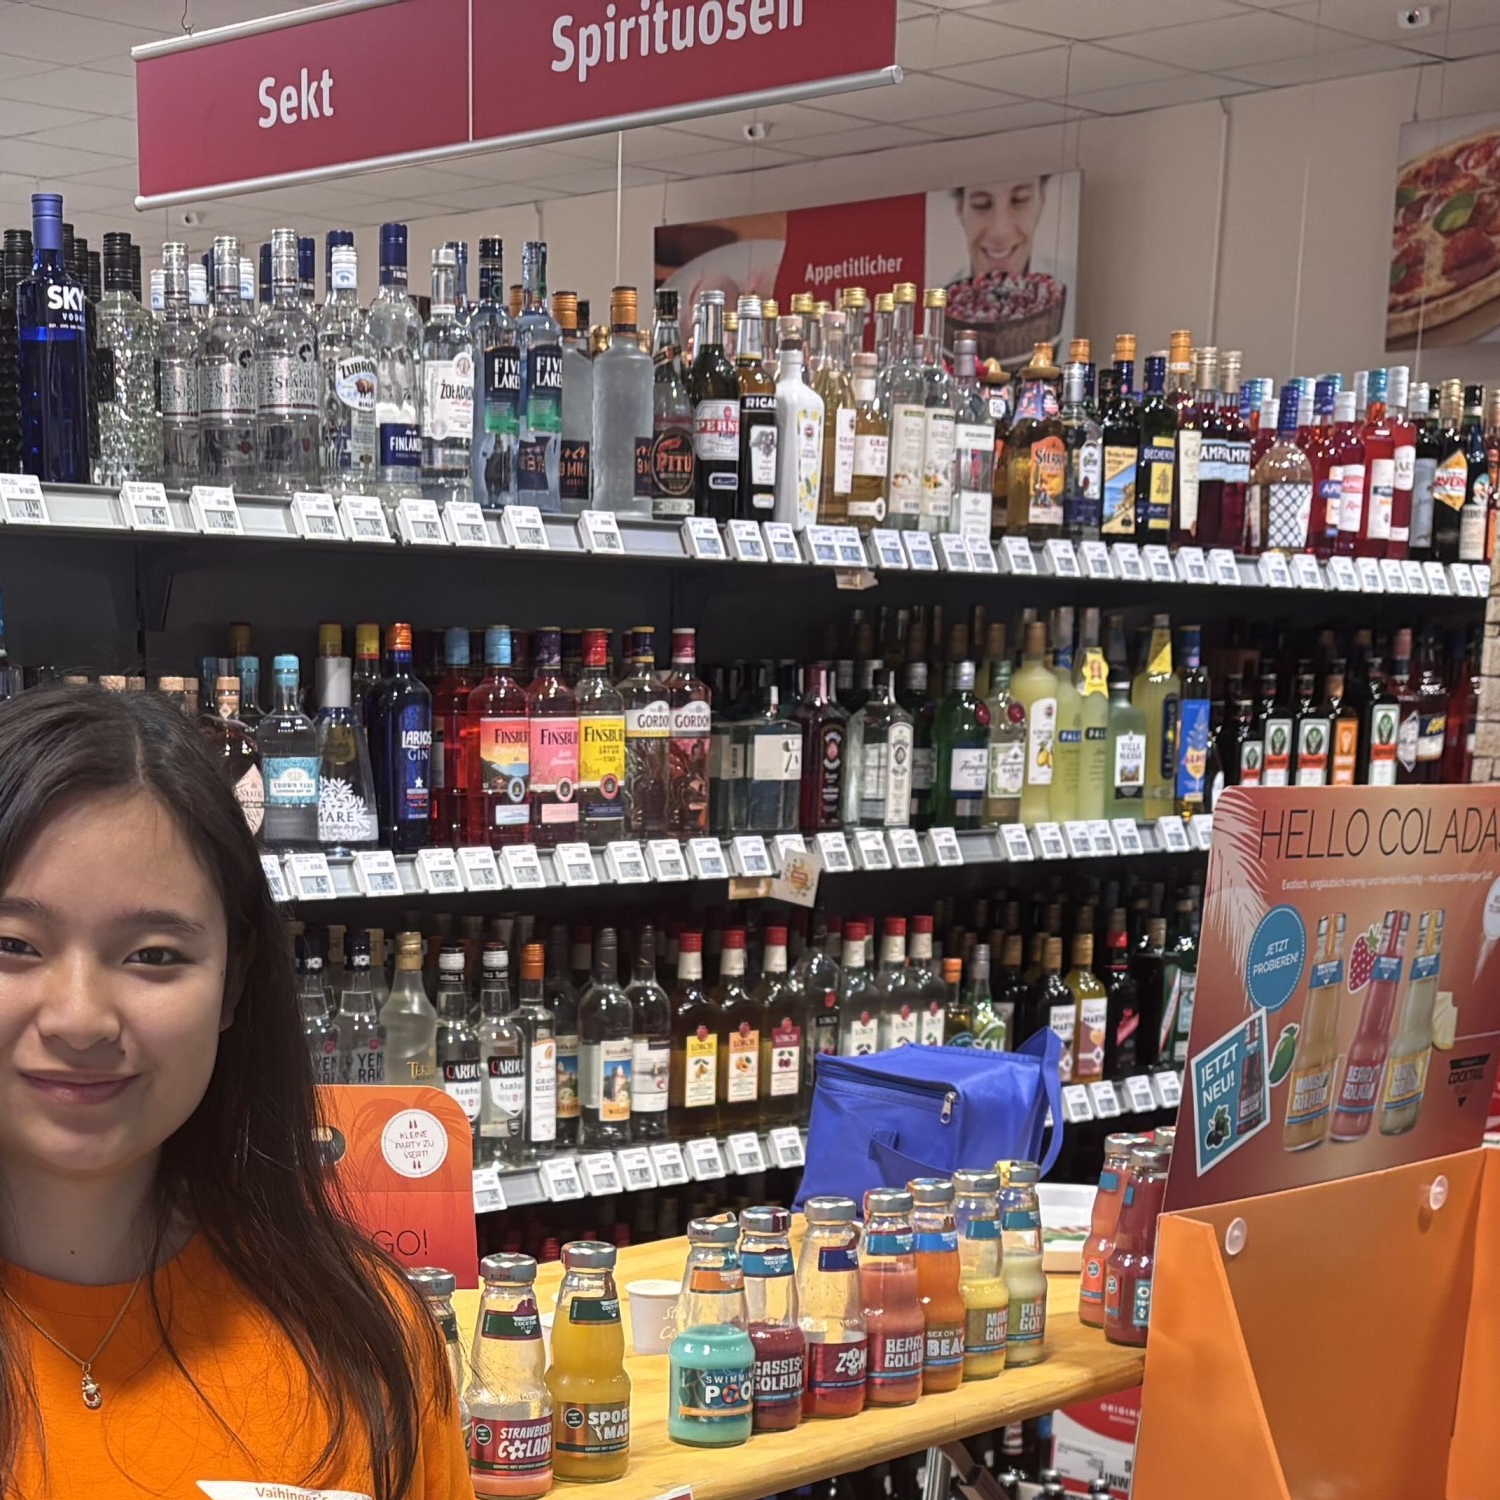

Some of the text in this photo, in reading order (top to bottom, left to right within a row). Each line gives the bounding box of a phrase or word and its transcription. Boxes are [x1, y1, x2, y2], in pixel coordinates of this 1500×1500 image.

[550, 0, 804, 84] Spirituosen
[257, 68, 334, 129] Sekt
[805, 257, 903, 283] Appetitlicher
[401, 730, 432, 749] LARIOS
[407, 748, 428, 761] GIN
[1259, 808, 1369, 860] HELLO
[1265, 938, 1289, 957] JETZT
[1252, 952, 1299, 977] PROBIEREN!
[1201, 1042, 1237, 1088] JETZT
[1202, 1075, 1235, 1107] NEU!
[394, 1140, 435, 1150] PARTY ZU
[400, 1131, 428, 1139] KLEINE
[403, 1150, 429, 1159] VIERT!
[371, 1229, 429, 1257] GO!
